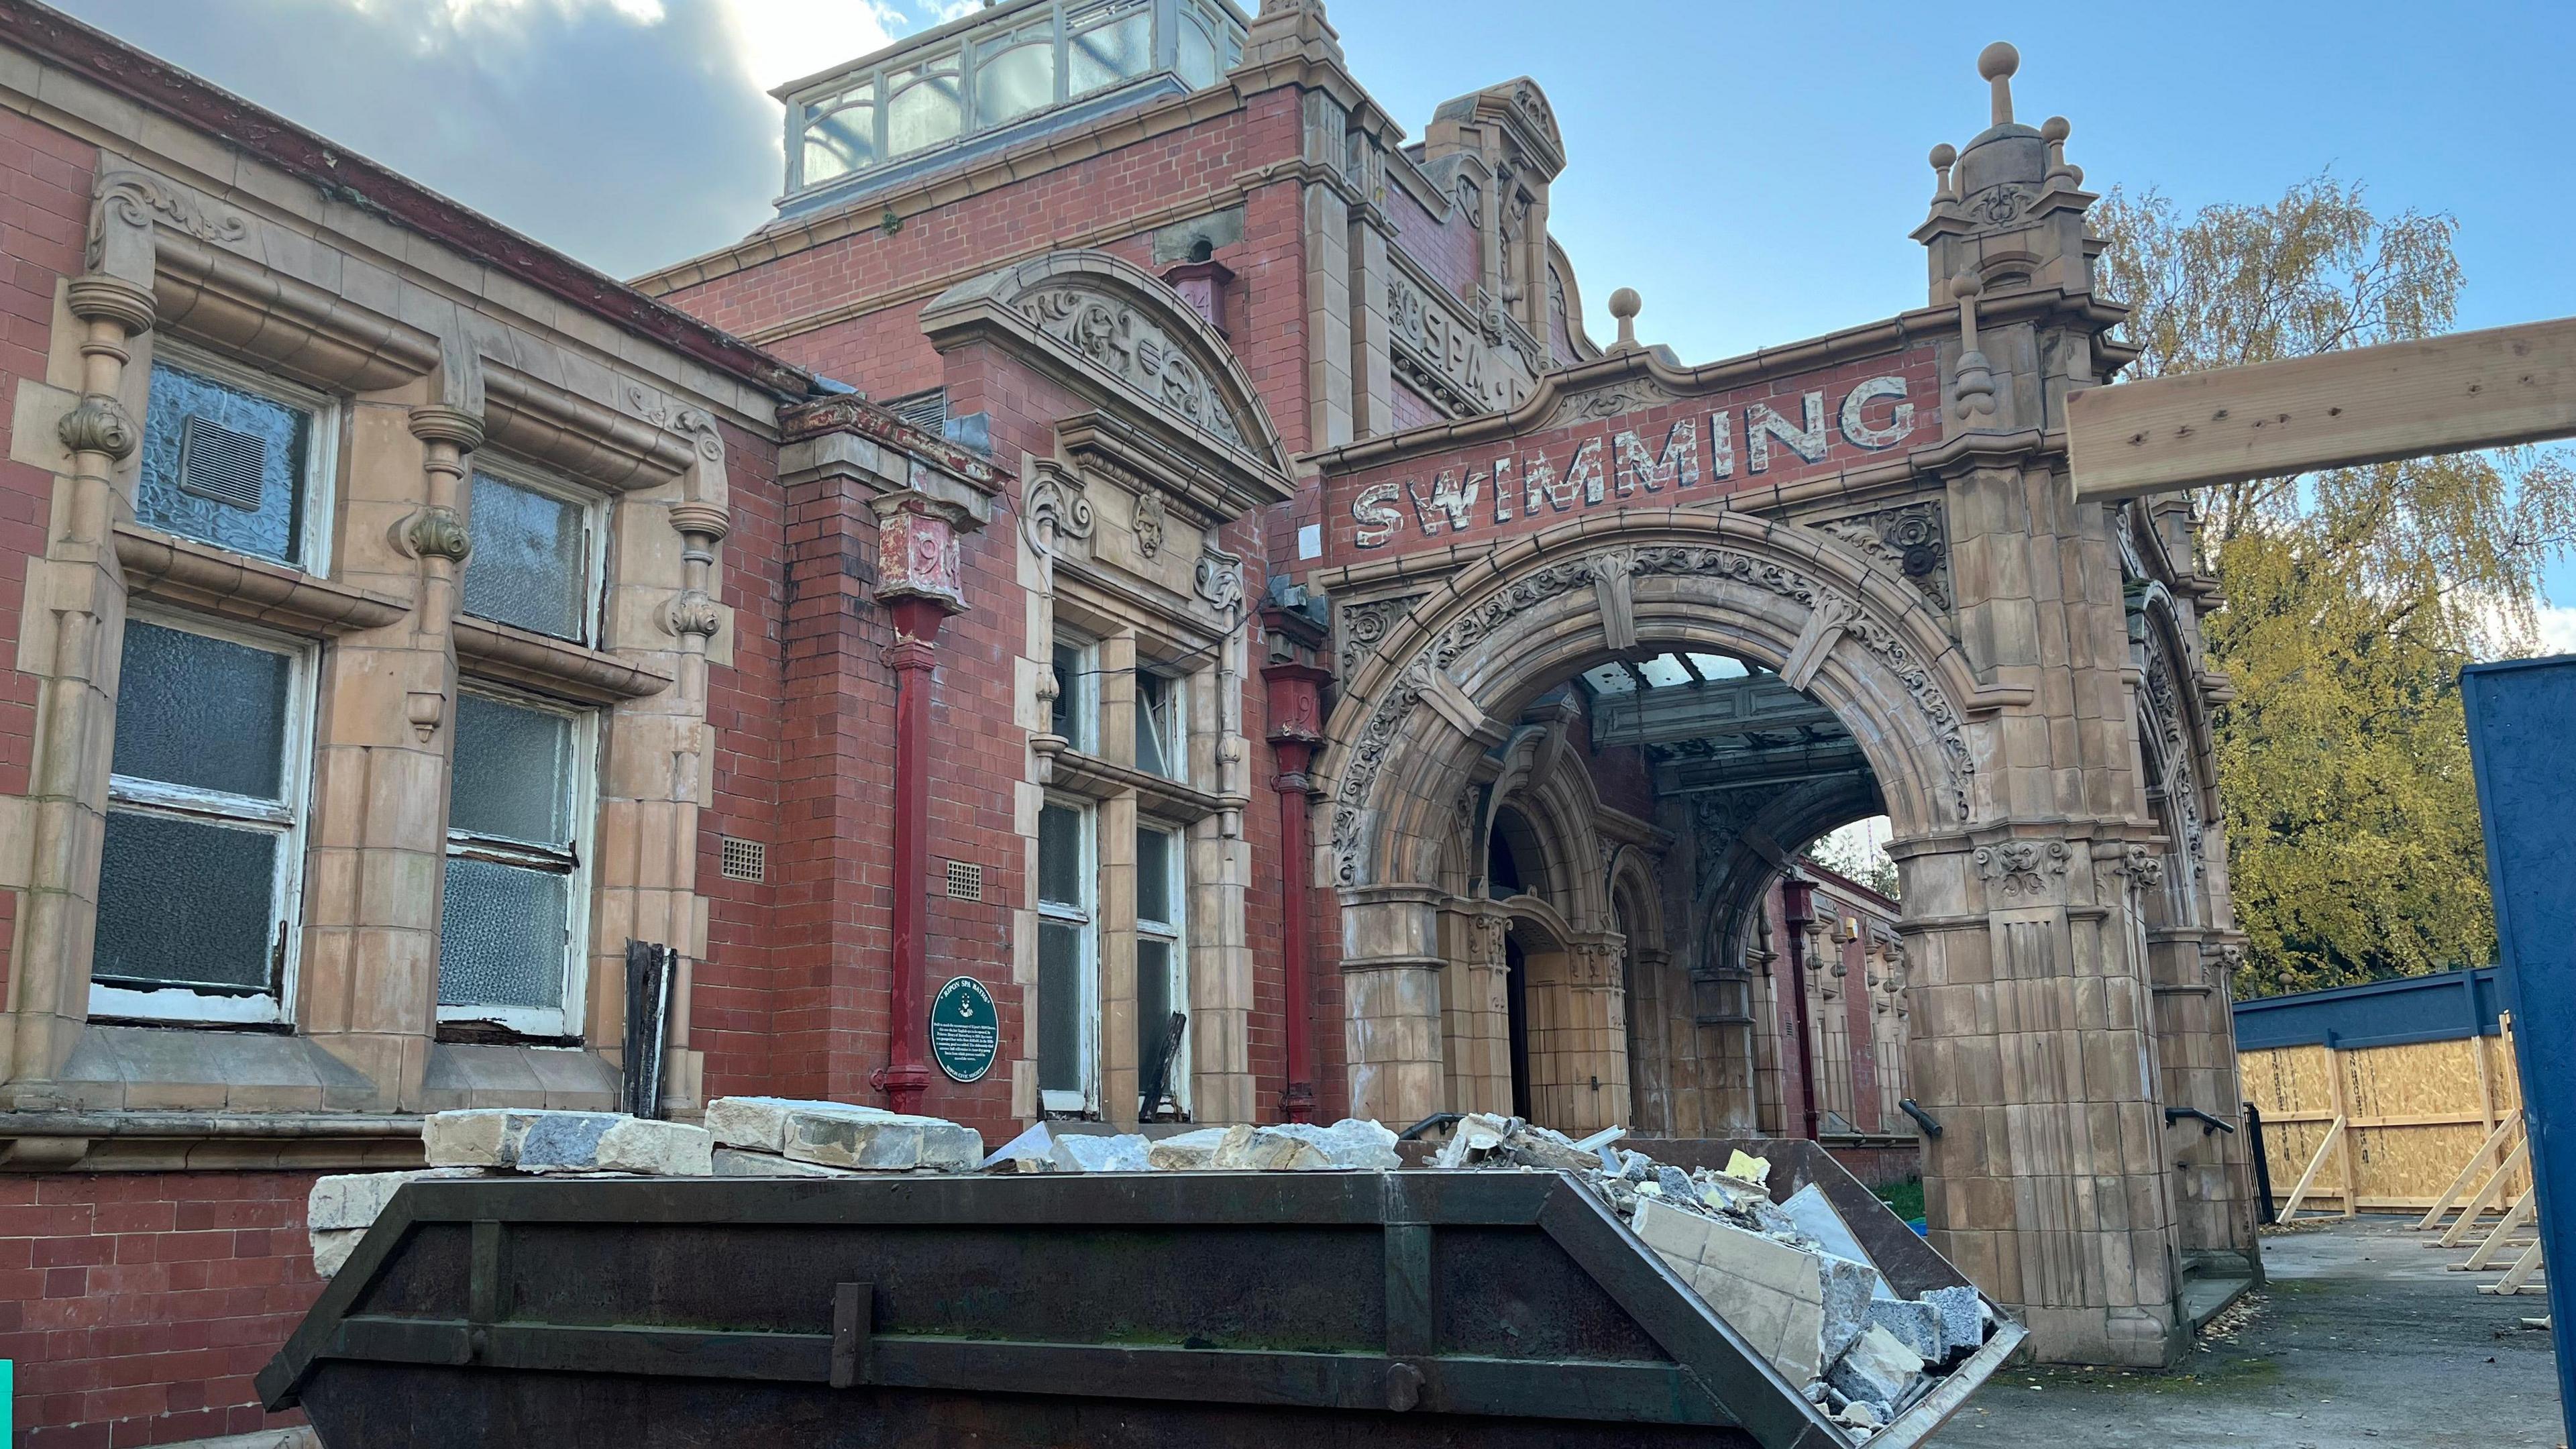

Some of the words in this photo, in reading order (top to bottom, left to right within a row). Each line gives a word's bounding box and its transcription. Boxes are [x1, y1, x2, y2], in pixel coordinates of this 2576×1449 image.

[1421, 305, 1489, 400] SPA
[1352, 376, 1915, 549] SWIMMING
[943, 981, 960, 998] RIPON
[973, 983, 989, 1002] BATHS
